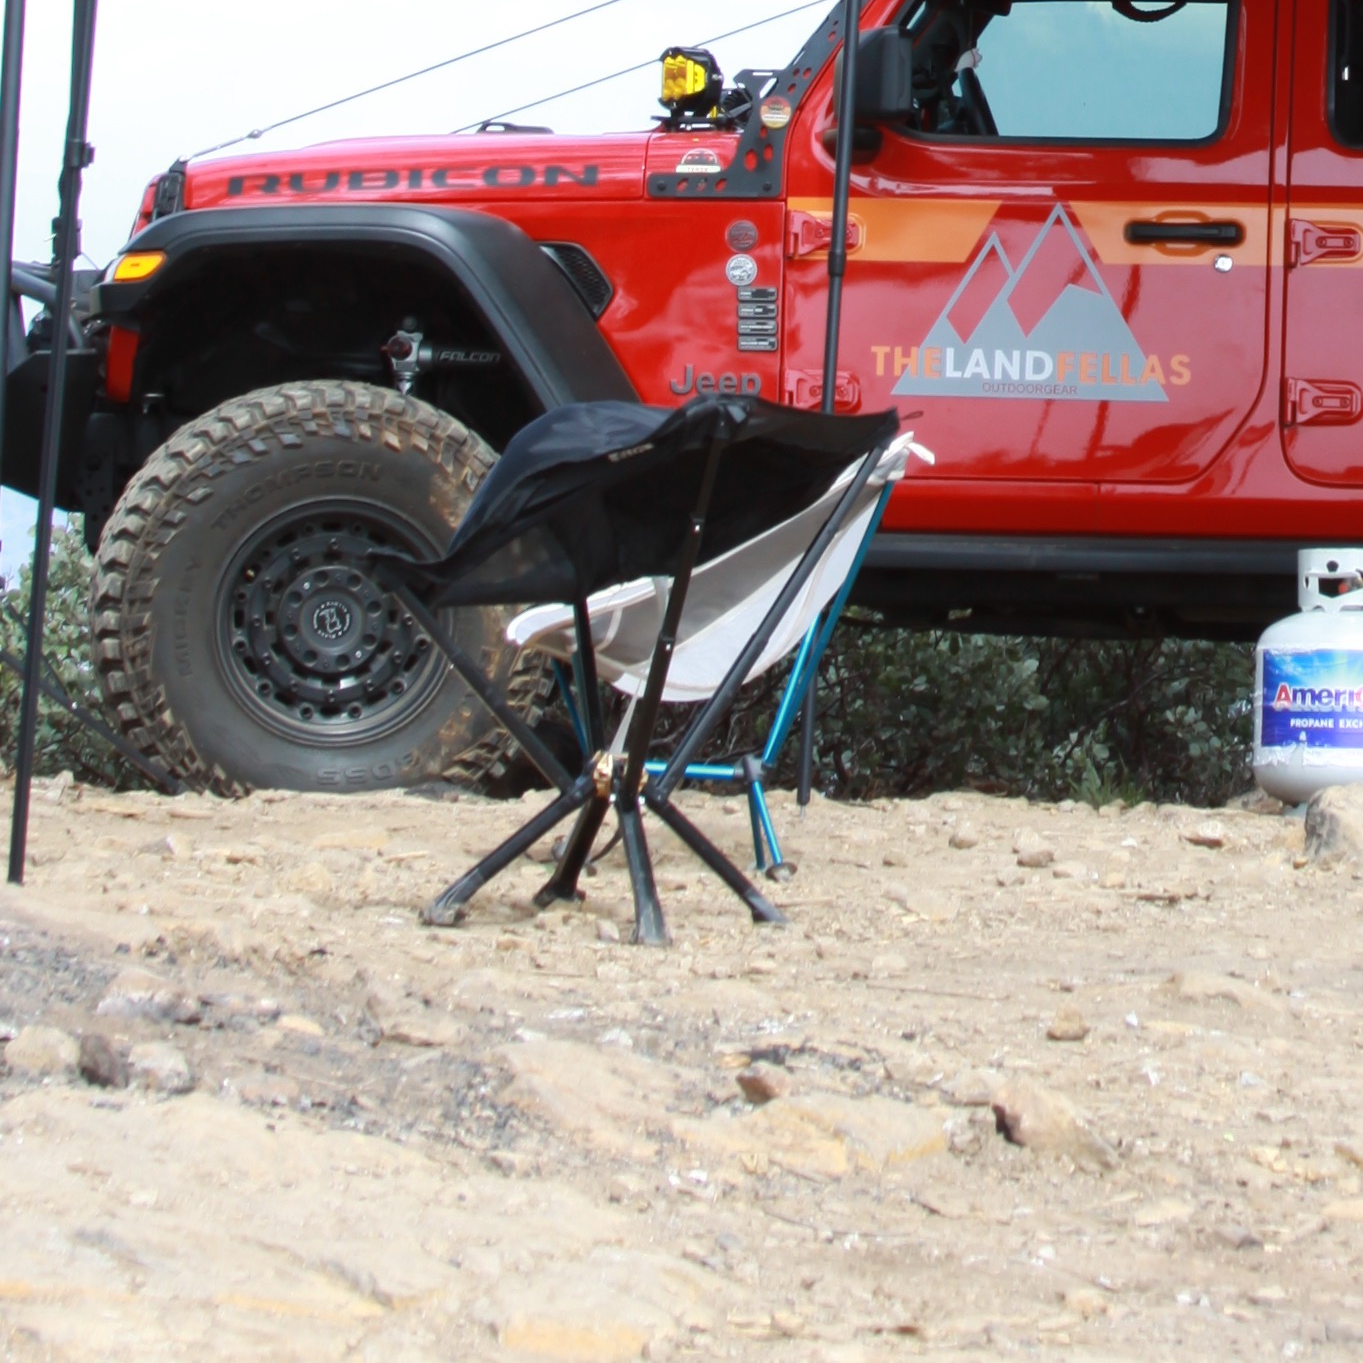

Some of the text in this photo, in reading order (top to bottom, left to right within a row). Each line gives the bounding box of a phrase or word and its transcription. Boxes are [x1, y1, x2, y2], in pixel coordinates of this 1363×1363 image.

[227, 164, 599, 197] RUBICON
[439, 350, 502, 363] FALCON
[670, 363, 762, 396] Jeep
[1290, 717, 1335, 729] PROPANE
